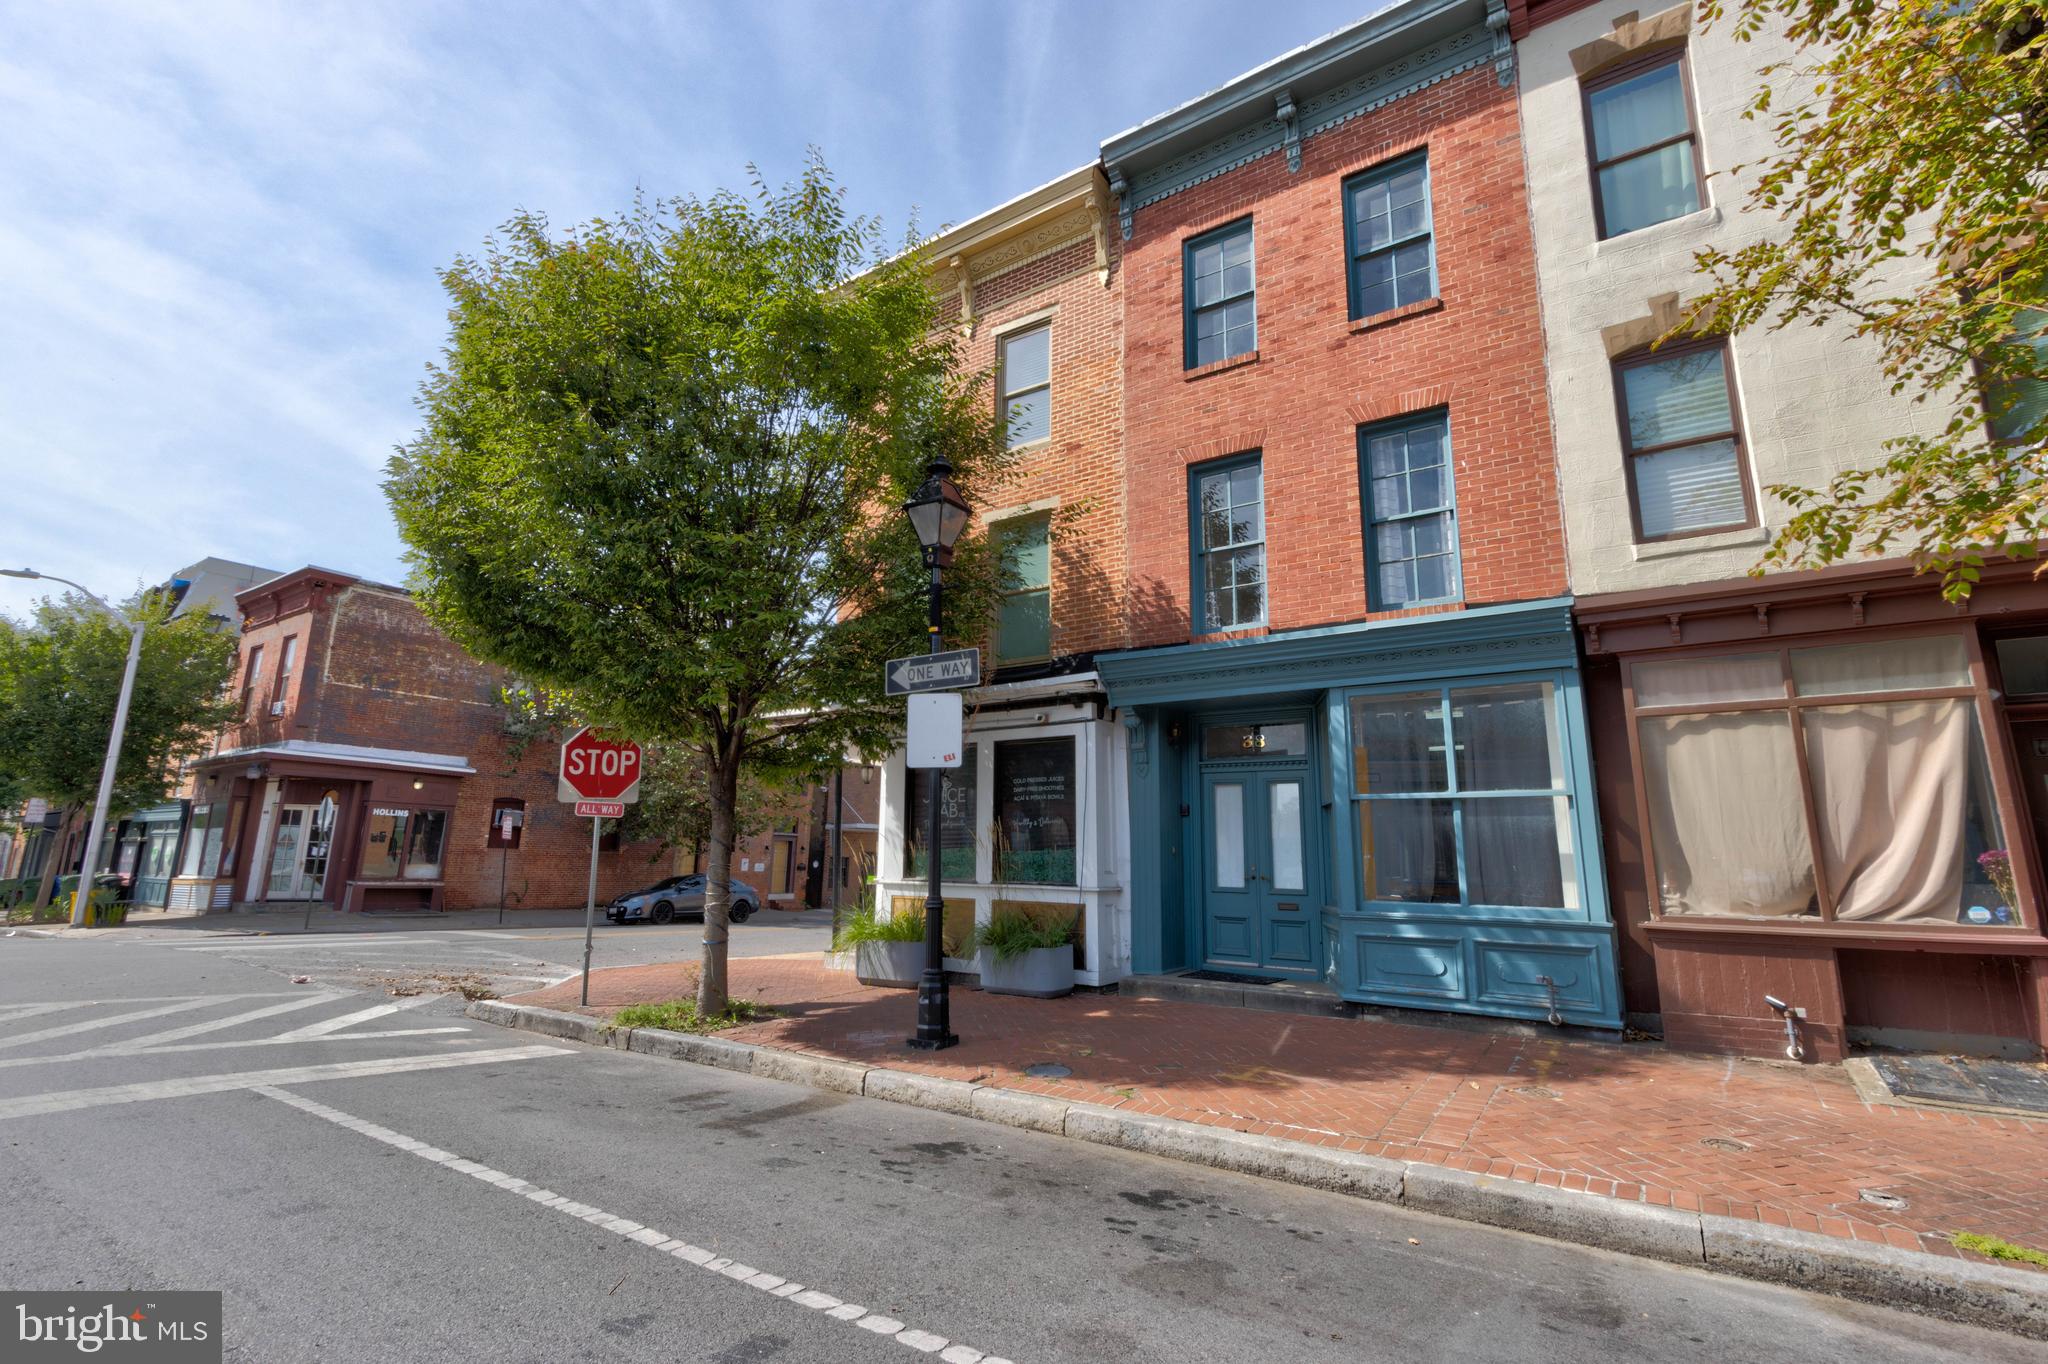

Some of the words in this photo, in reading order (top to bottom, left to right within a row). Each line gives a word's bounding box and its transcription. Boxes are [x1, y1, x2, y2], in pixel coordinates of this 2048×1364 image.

[907, 666, 934, 681] ONE
[941, 661, 969, 676] WAY
[568, 748, 637, 776] STOP
[373, 808, 409, 817] HOLLINS
[580, 804, 597, 814] ALL
[601, 805, 620, 814] WAY
